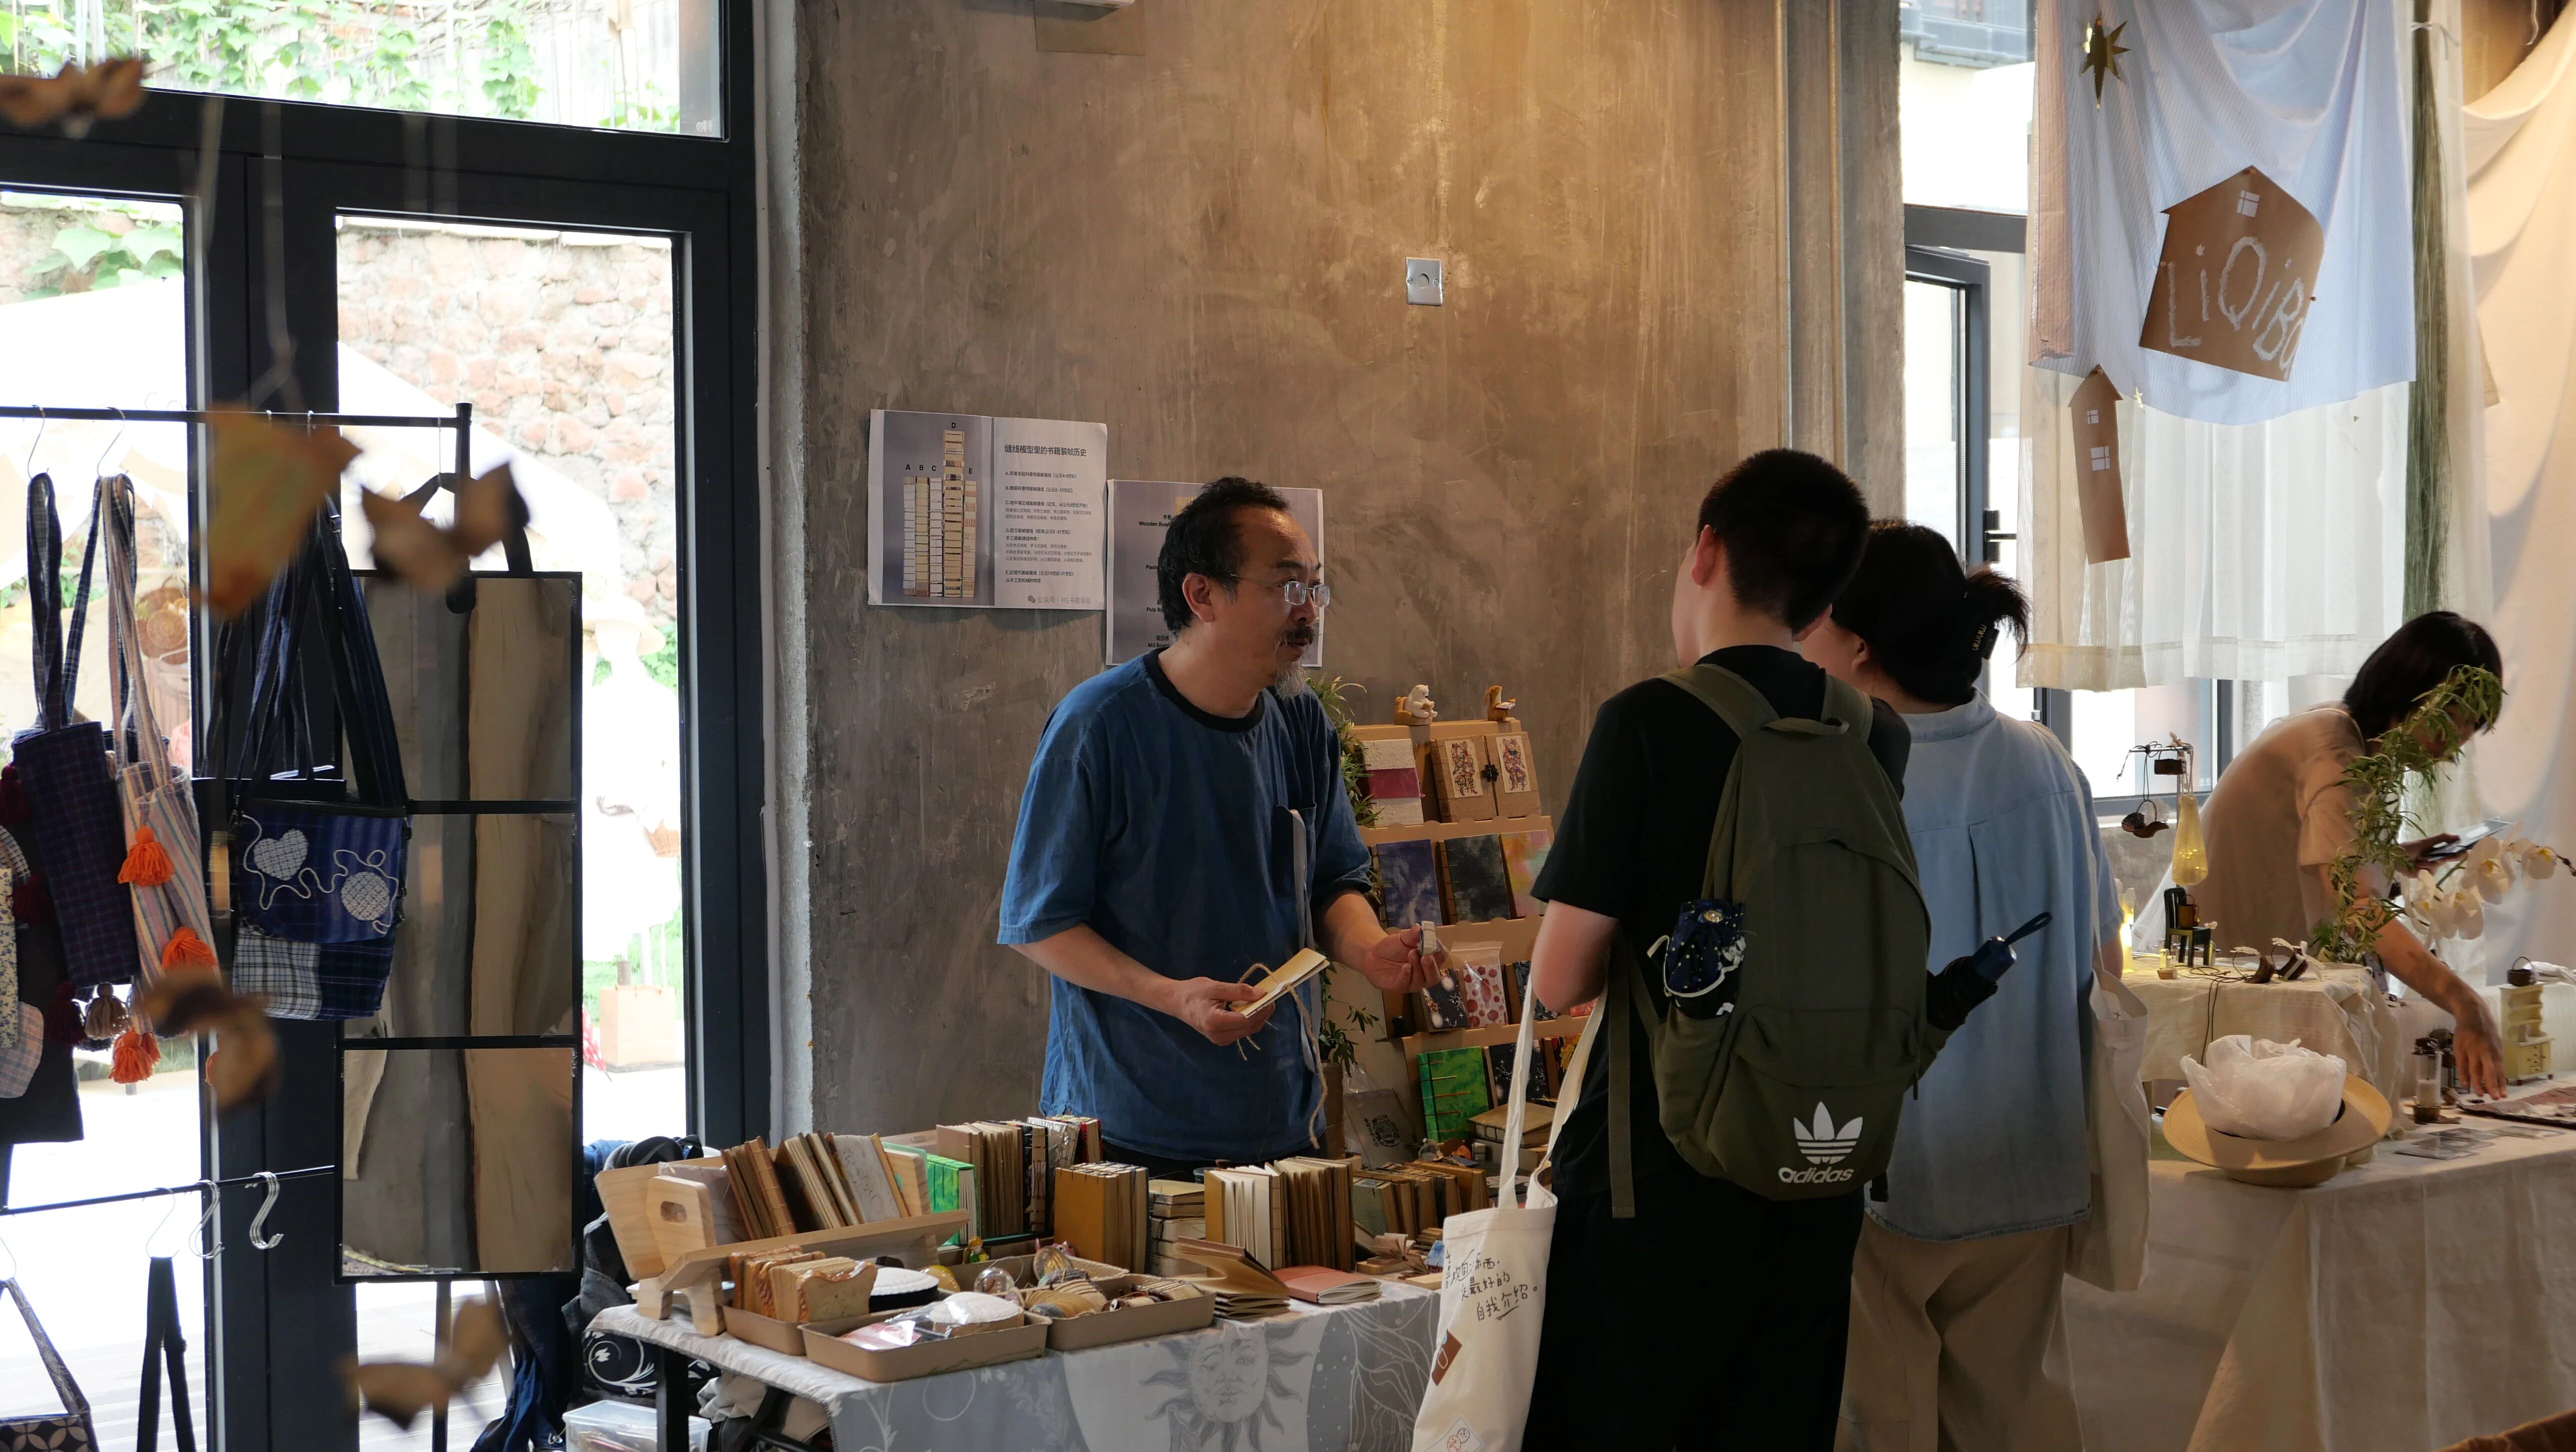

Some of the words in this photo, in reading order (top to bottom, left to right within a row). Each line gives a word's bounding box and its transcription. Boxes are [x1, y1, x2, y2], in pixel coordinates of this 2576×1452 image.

[1004, 444, 1087, 456] 缝线模型里的书籍装帧历史
[1778, 1166, 1854, 1184] adidas
